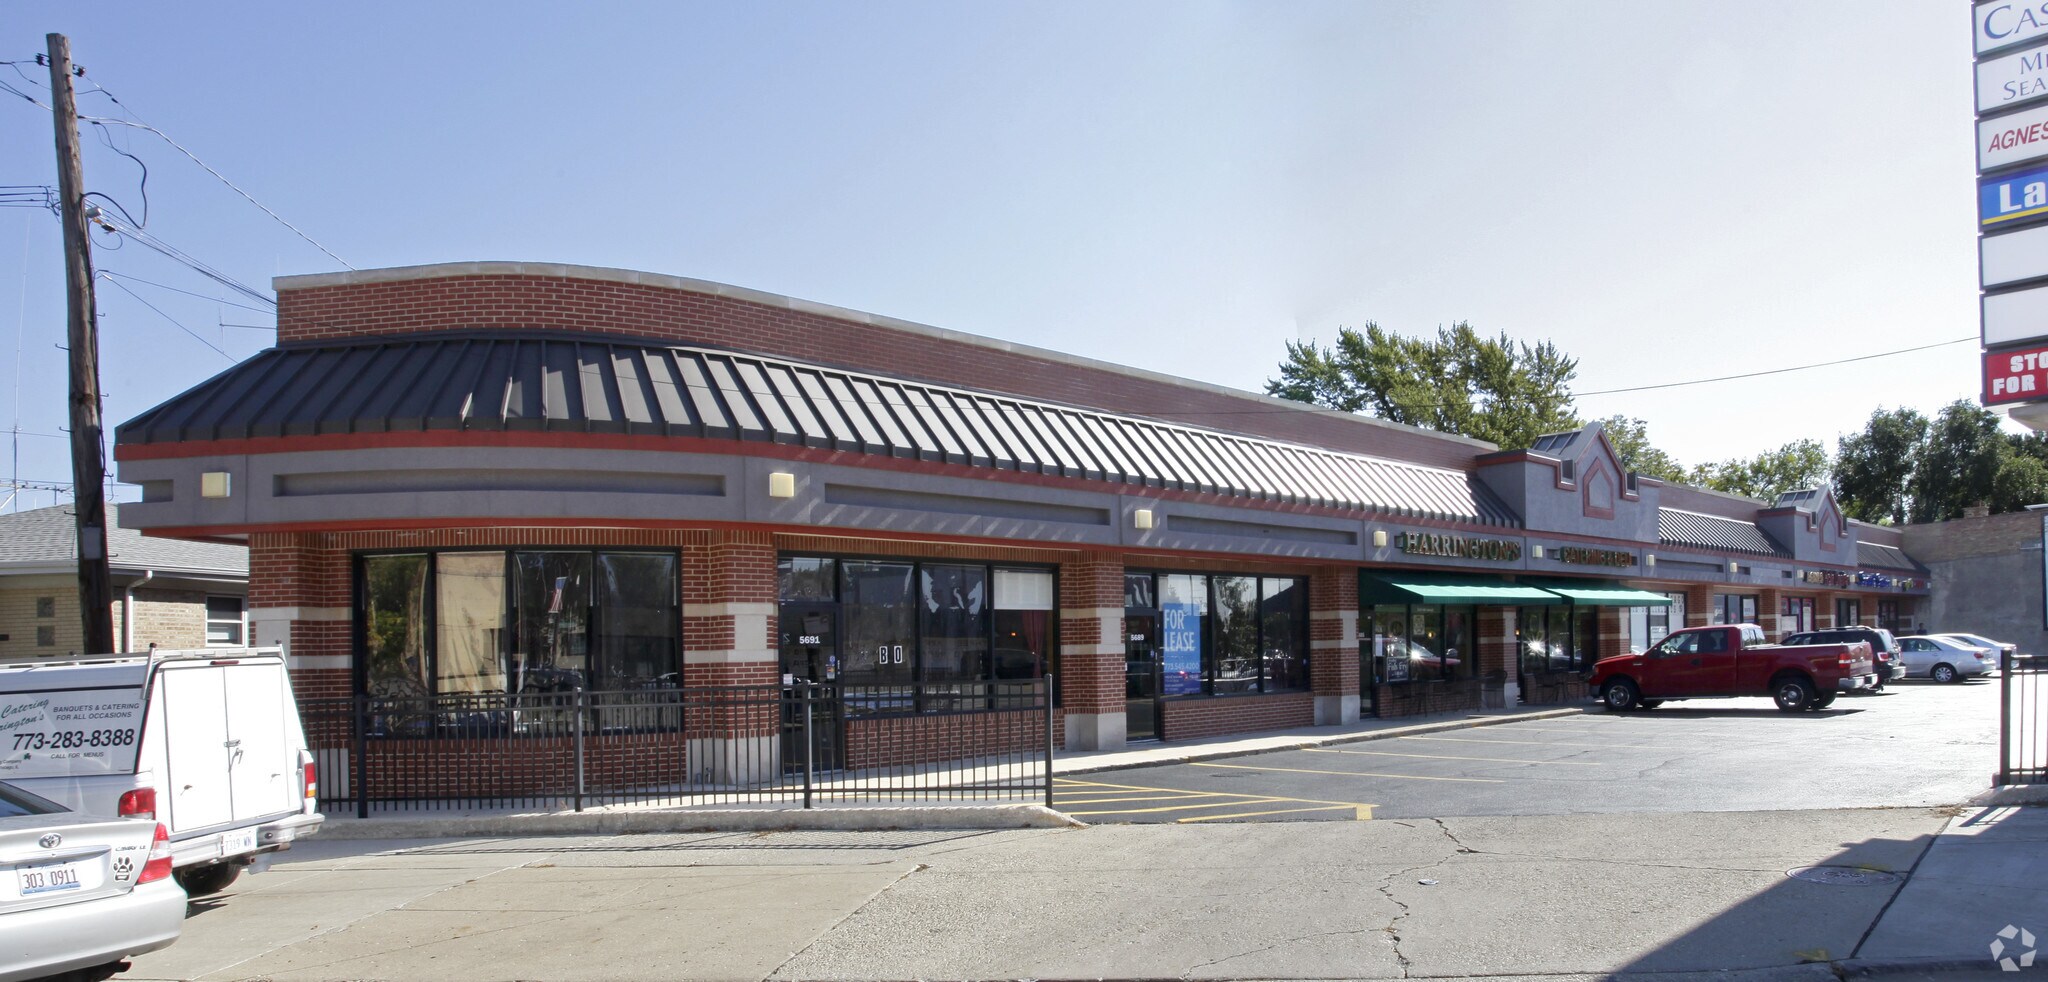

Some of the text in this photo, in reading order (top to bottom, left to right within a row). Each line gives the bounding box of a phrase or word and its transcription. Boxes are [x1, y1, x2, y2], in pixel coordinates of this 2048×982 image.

[2003, 77, 2047, 100] SEA
[1988, 121, 2048, 153] AGNES
[2000, 181, 2046, 213] La
[1993, 374, 2036, 395] FOR
[1164, 609, 1184, 630] FOR
[799, 635, 821, 644] 5691
[1164, 631, 1195, 652] LEASE
[1, 699, 49, 719] Catering
[53, 704, 94, 713] BANQUETS
[101, 703, 140, 711] CATERING
[89, 711, 132, 719] OCCASIONS
[13, 728, 135, 751] 773-283-8388
[22, 868, 79, 889] 303 0911
